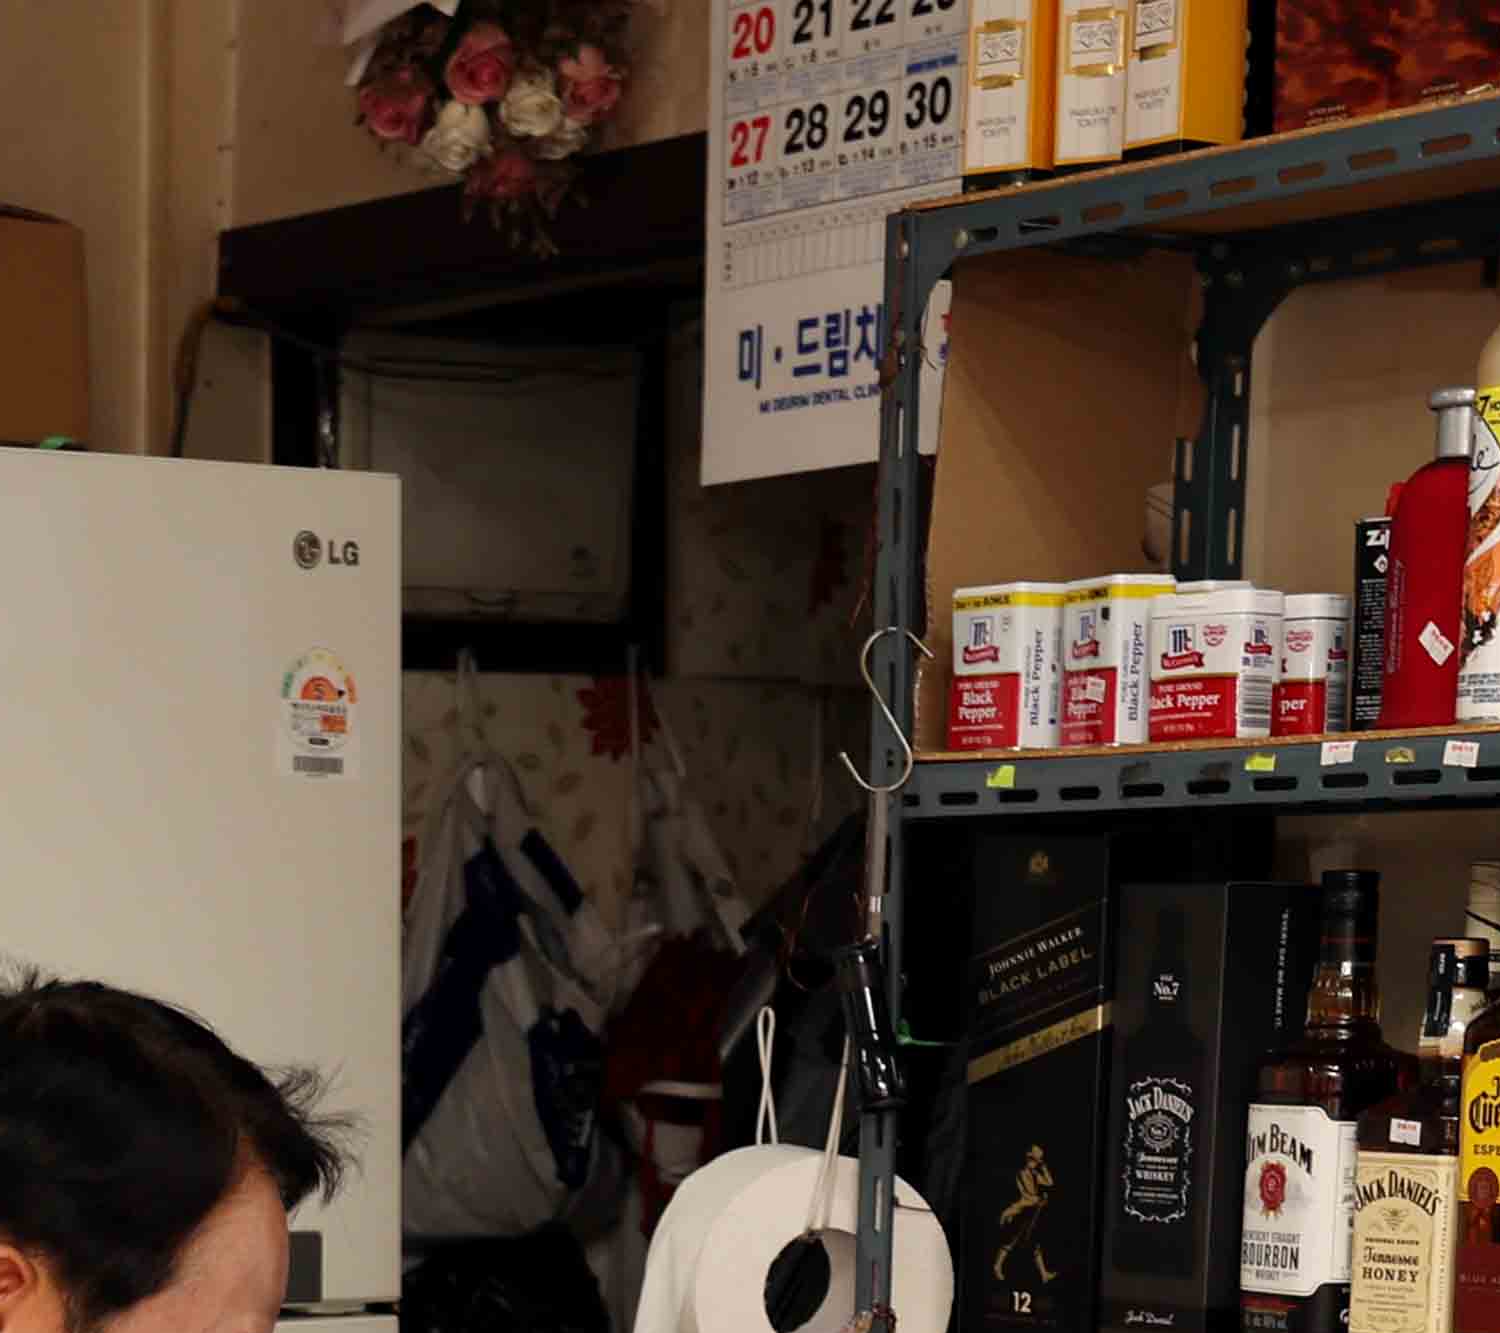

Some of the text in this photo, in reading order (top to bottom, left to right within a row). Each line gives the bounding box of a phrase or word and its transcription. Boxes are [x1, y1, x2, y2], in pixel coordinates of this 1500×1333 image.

[732, 8, 776, 60] 20
[793, 0, 832, 44] 21
[730, 76, 953, 168] 27 28 29 30
[328, 540, 360, 566] LG
[1032, 629, 1044, 681] Pepper
[1131, 622, 1143, 675] Pepper
[961, 689, 993, 706] Black
[1152, 693, 1220, 711] lack Pepper
[958, 706, 998, 724] Pepper
[988, 926, 1085, 977] JOHNNIE WALKER
[979, 946, 1093, 1004] BLACK LABEL
[1153, 980, 1181, 999] No.7
[1126, 1093, 1152, 1122] JACK
[1269, 1123, 1314, 1176] BEAM
[1354, 1169, 1443, 1217] JACK DANIEL'S
[1242, 1243, 1300, 1271] BOURBON
[1362, 1245, 1420, 1267] Tennessee
[1361, 1266, 1420, 1284] HONEY
[1012, 1290, 1032, 1314] 12
